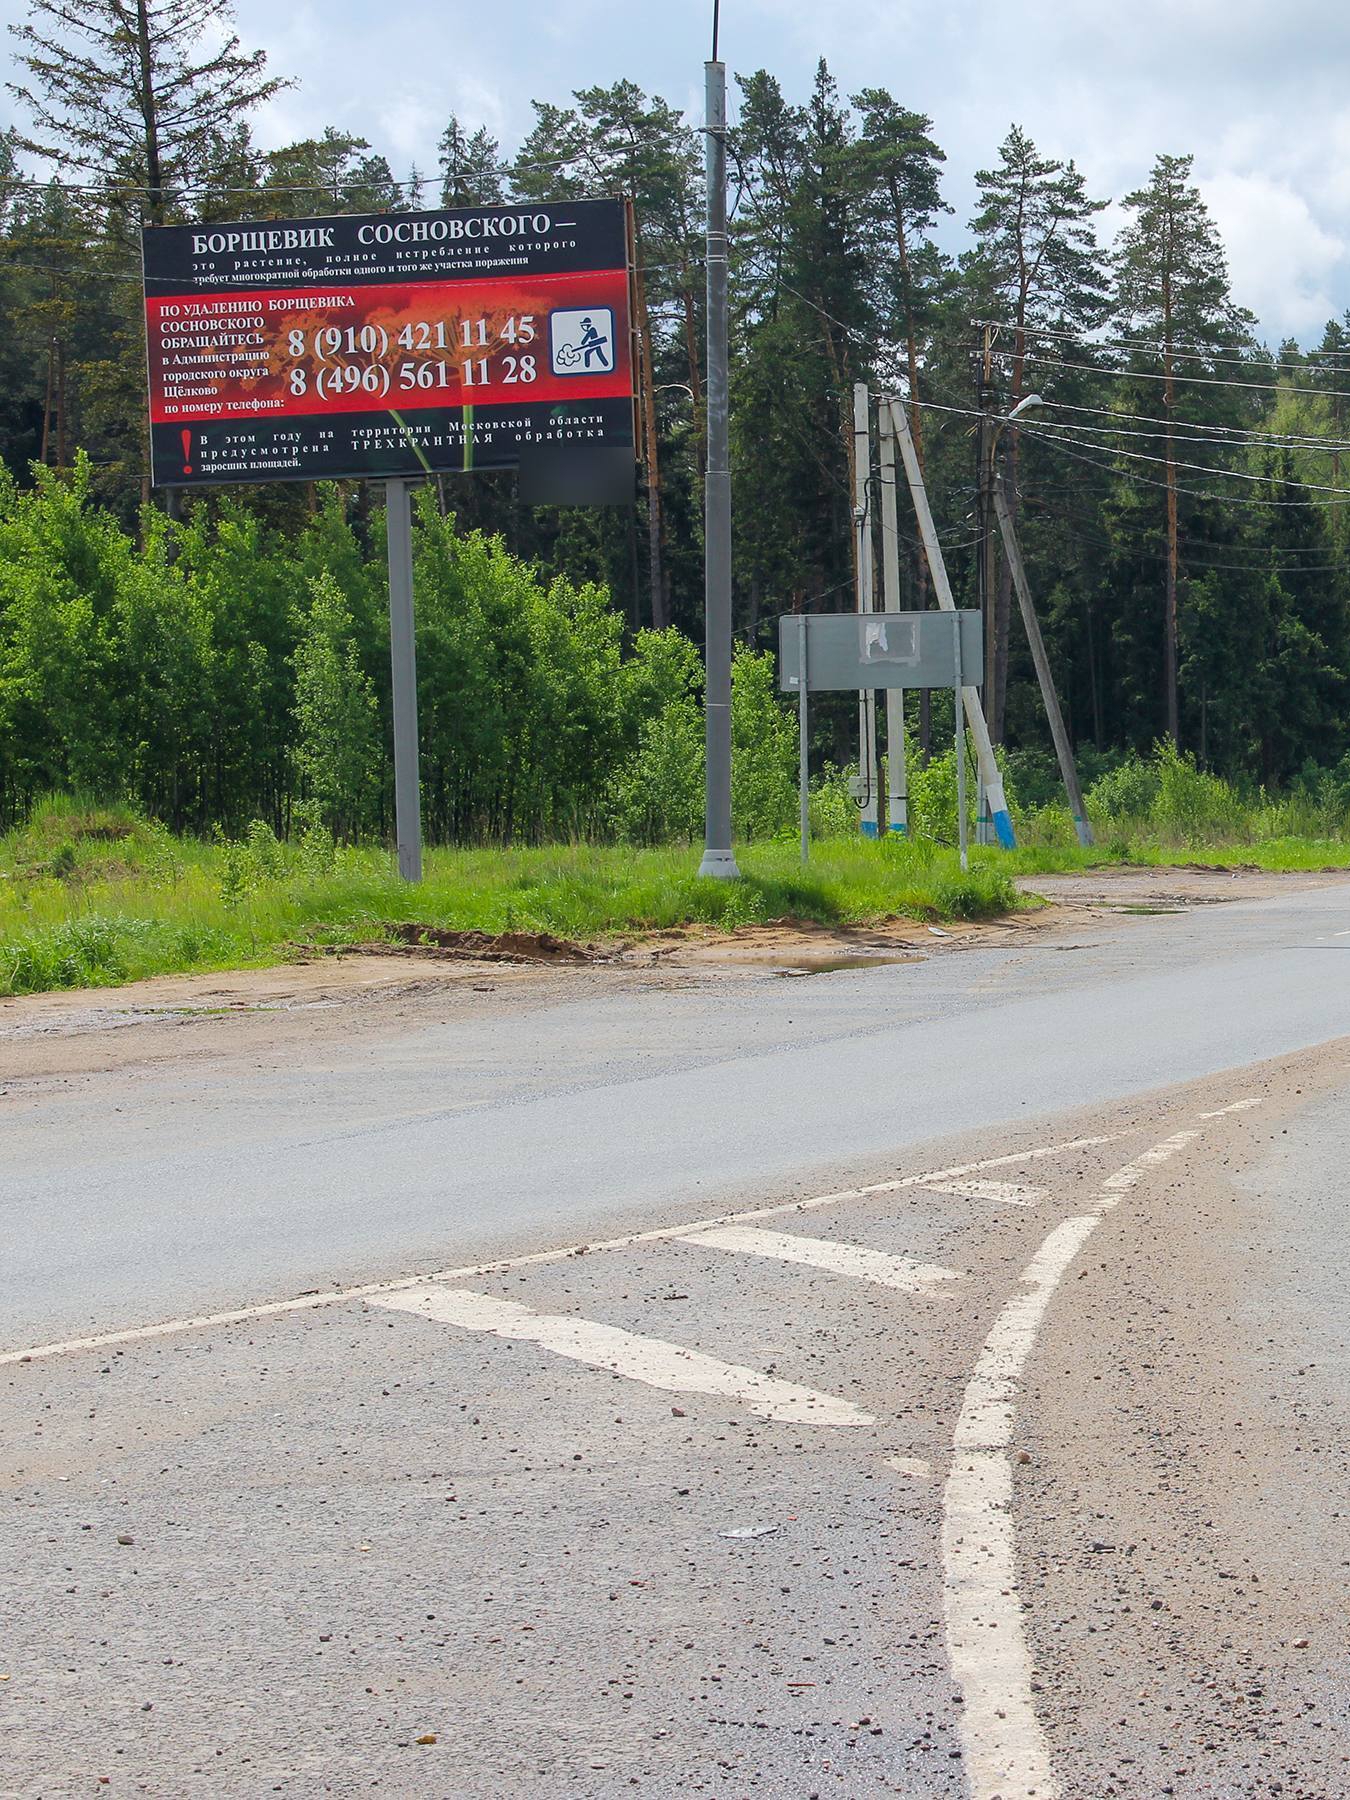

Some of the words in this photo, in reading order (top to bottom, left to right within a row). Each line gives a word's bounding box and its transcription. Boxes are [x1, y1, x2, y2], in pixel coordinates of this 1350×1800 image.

[192, 227, 335, 255] БОРЩЕВИК
[357, 213, 551, 245] СОСНОВСКОГО
[192, 261, 215, 271] это
[234, 257, 308, 271] растение,
[326, 252, 378, 264] полное
[396, 245, 490, 260] истребление
[509, 238, 577, 253] которого
[192, 273, 230, 286] требует
[231, 268, 300, 284] многократной
[301, 265, 352, 281] обработки
[353, 263, 386, 277] одного
[388, 264, 395, 273] и
[396, 262, 418, 273] того
[419, 261, 433, 271] же
[434, 258, 474, 273] участка
[474, 253, 529, 271] поражения
[159, 304, 180, 317] ПО
[183, 300, 263, 318] УДАЛЕНИЮ
[268, 295, 356, 312] БОРЩЕВИКА
[160, 316, 265, 334] СОСНОВСКОГО
[160, 332, 264, 350] ОБРАЩАЙТЕСЬ
[288, 329, 305, 357] 8
[314, 324, 389, 362] (910)
[397, 319, 448, 352] 421
[459, 316, 490, 349] 11
[498, 314, 536, 345] 45
[162, 357, 170, 366] в
[172, 349, 270, 367] Администрацию
[162, 369, 226, 384] городского
[228, 366, 269, 381] округа
[289, 367, 307, 397] 8
[316, 363, 390, 401] (496)
[399, 358, 450, 391] 561
[461, 357, 492, 388] 11
[501, 353, 537, 385] 28
[163, 384, 218, 399] Щёлково
[164, 404, 179, 415] по
[181, 401, 223, 416] номеру
[226, 396, 286, 414] телефона:
[199, 434, 209, 446] В
[225, 433, 256, 444] этом
[272, 430, 302, 443] году
[319, 428, 335, 439] на
[350, 425, 432, 439] территории
[448, 416, 532, 432] Московской
[549, 413, 604, 427] области
[200, 443, 329, 461] предусмотрена
[515, 427, 605, 443] обработка
[200, 459, 249, 474] заросших
[249, 455, 303, 471] площадей.
